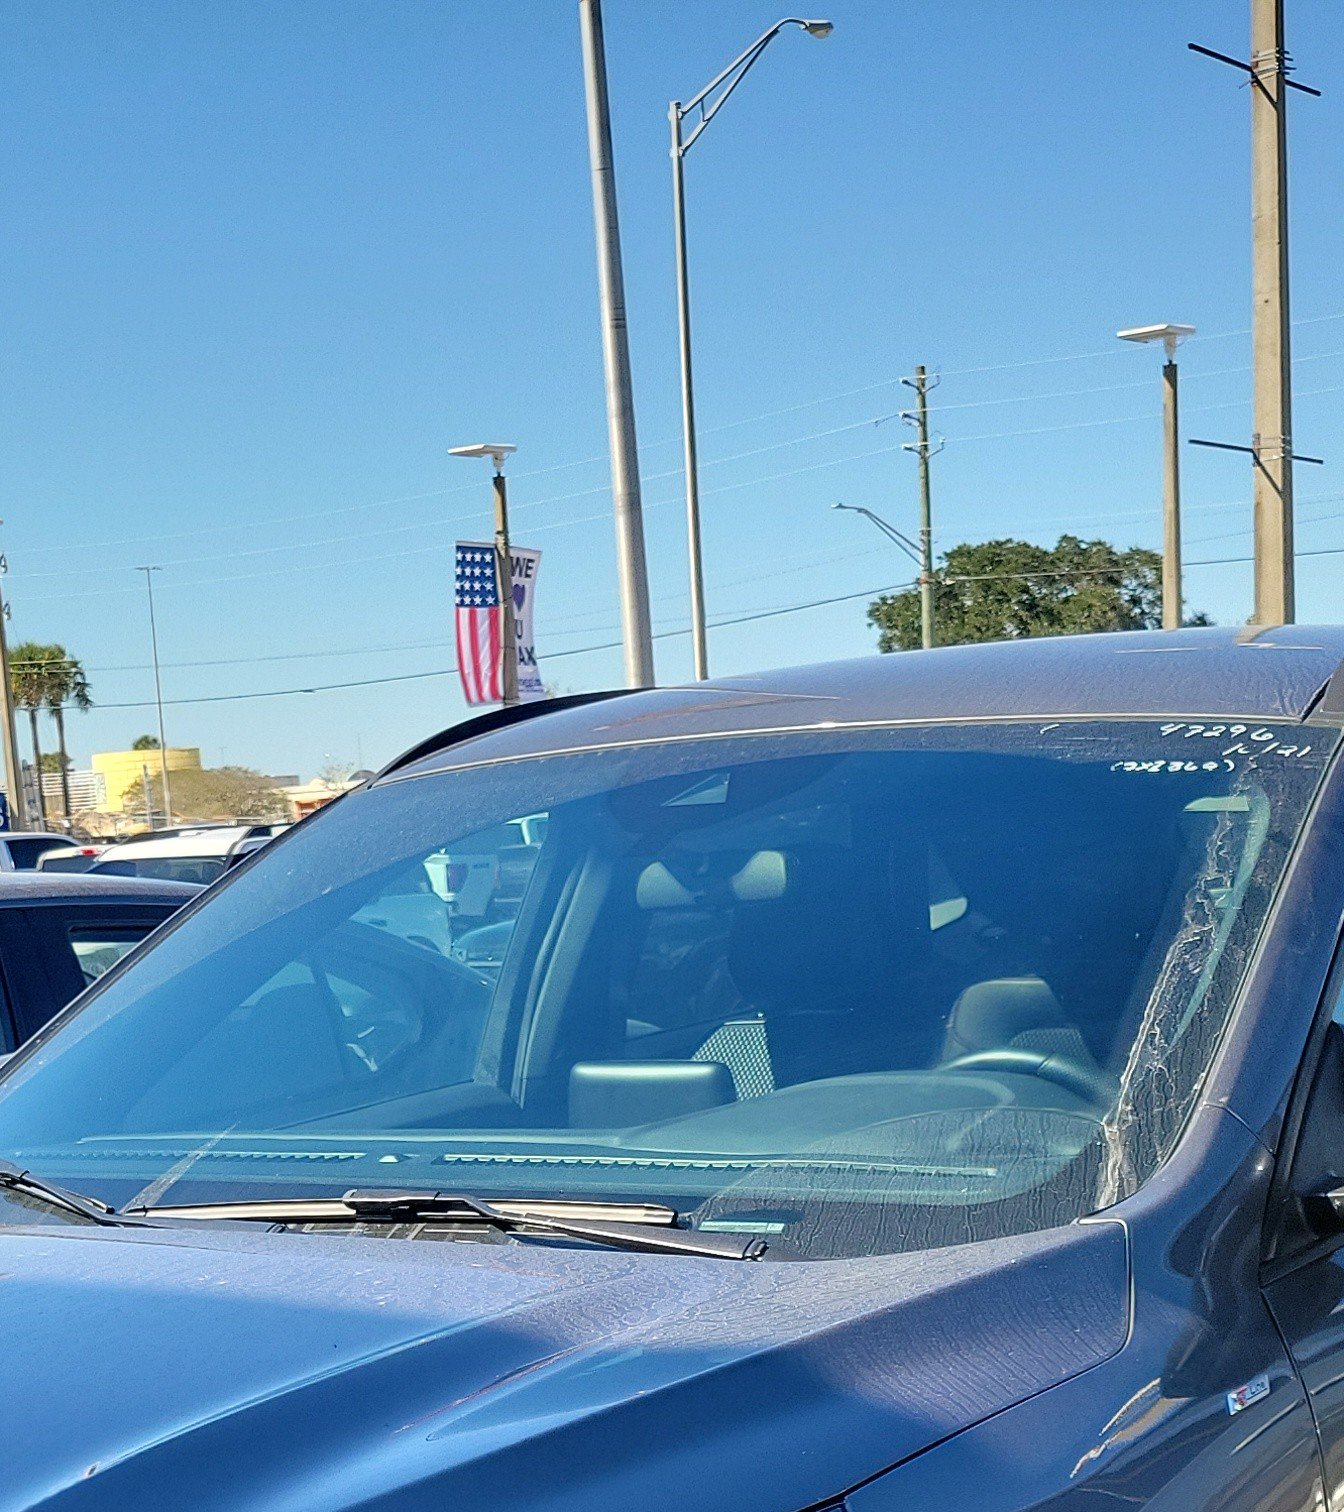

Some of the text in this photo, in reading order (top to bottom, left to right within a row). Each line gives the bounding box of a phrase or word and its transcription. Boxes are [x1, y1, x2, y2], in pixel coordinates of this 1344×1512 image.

[510, 556, 535, 578] WE
[515, 618, 523, 640] U
[518, 646, 537, 666] AX
